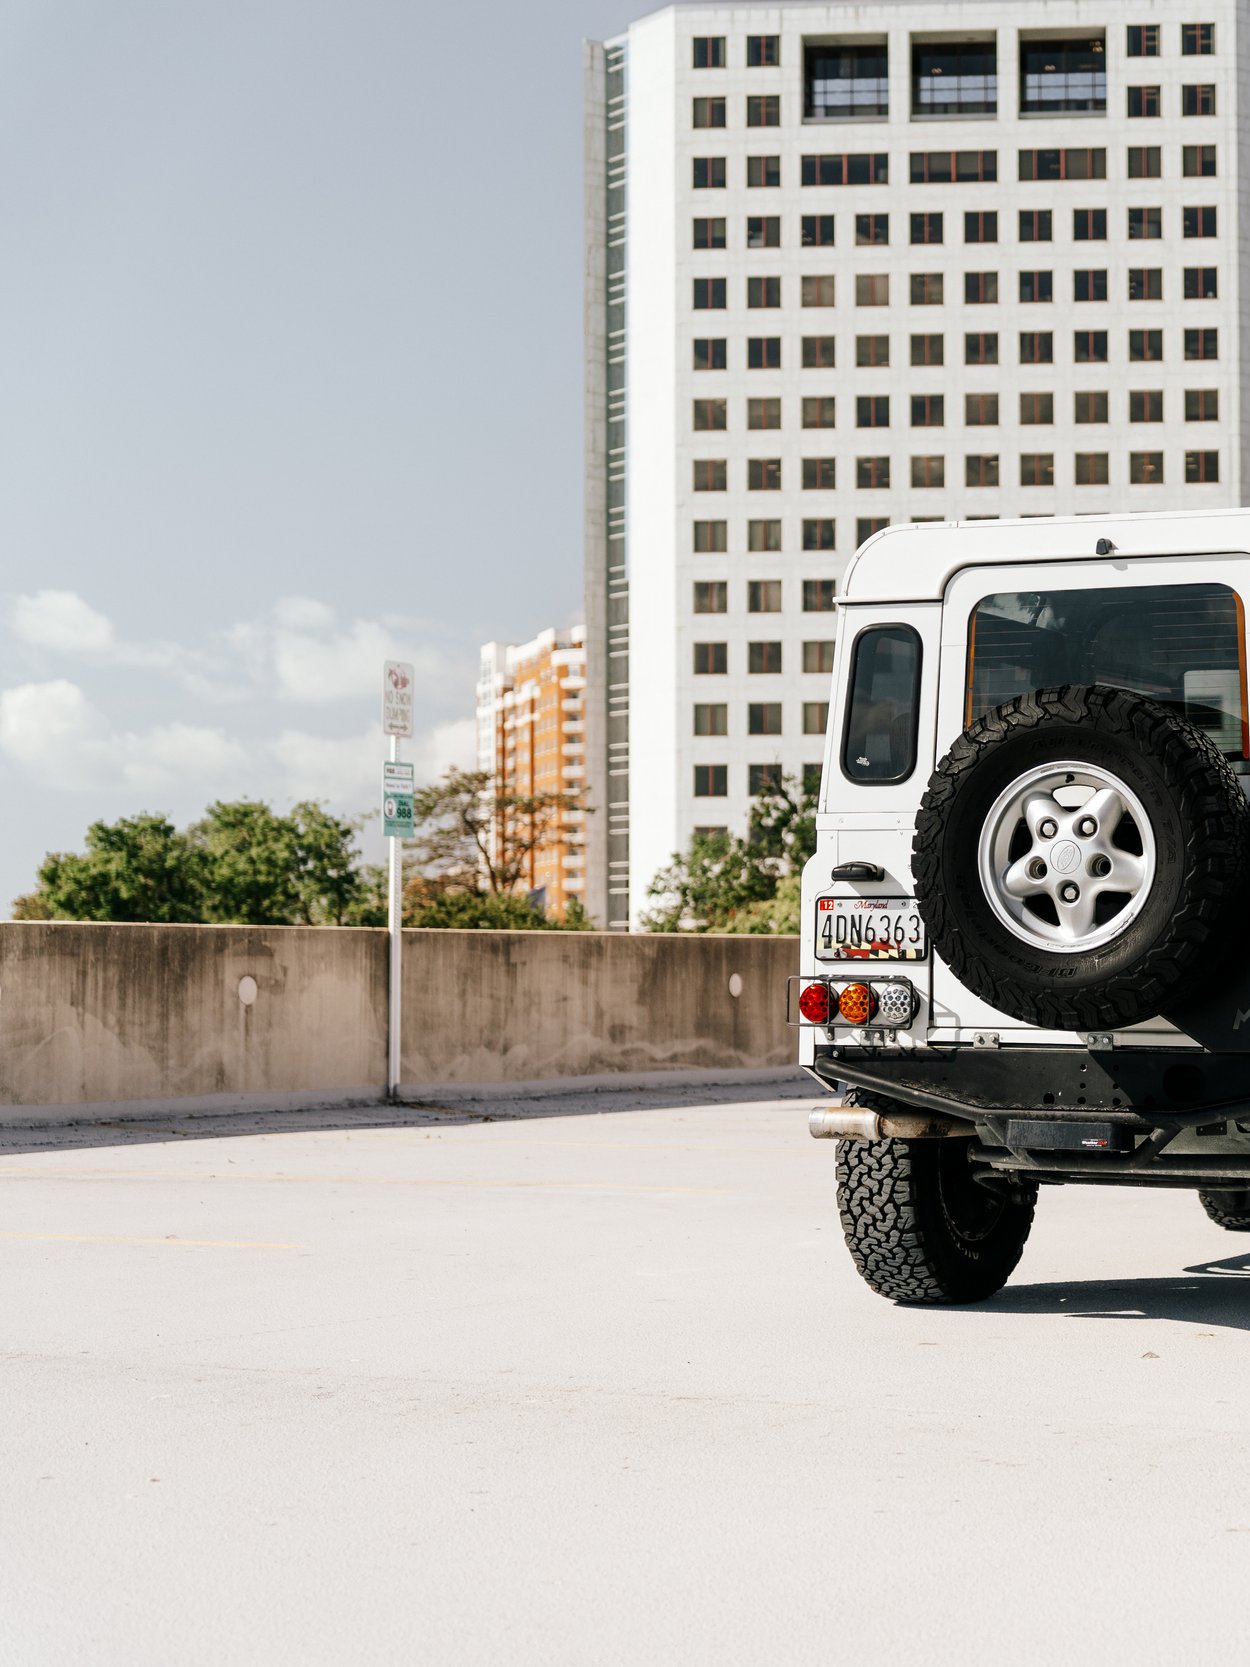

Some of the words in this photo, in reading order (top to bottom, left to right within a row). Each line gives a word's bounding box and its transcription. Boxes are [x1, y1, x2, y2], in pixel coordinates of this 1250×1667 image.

[398, 799, 409, 807] DIAL
[396, 807, 412, 819] 988
[824, 901, 833, 909] 12
[854, 900, 889, 911] Maryland
[822, 914, 920, 945] 4DN6363
